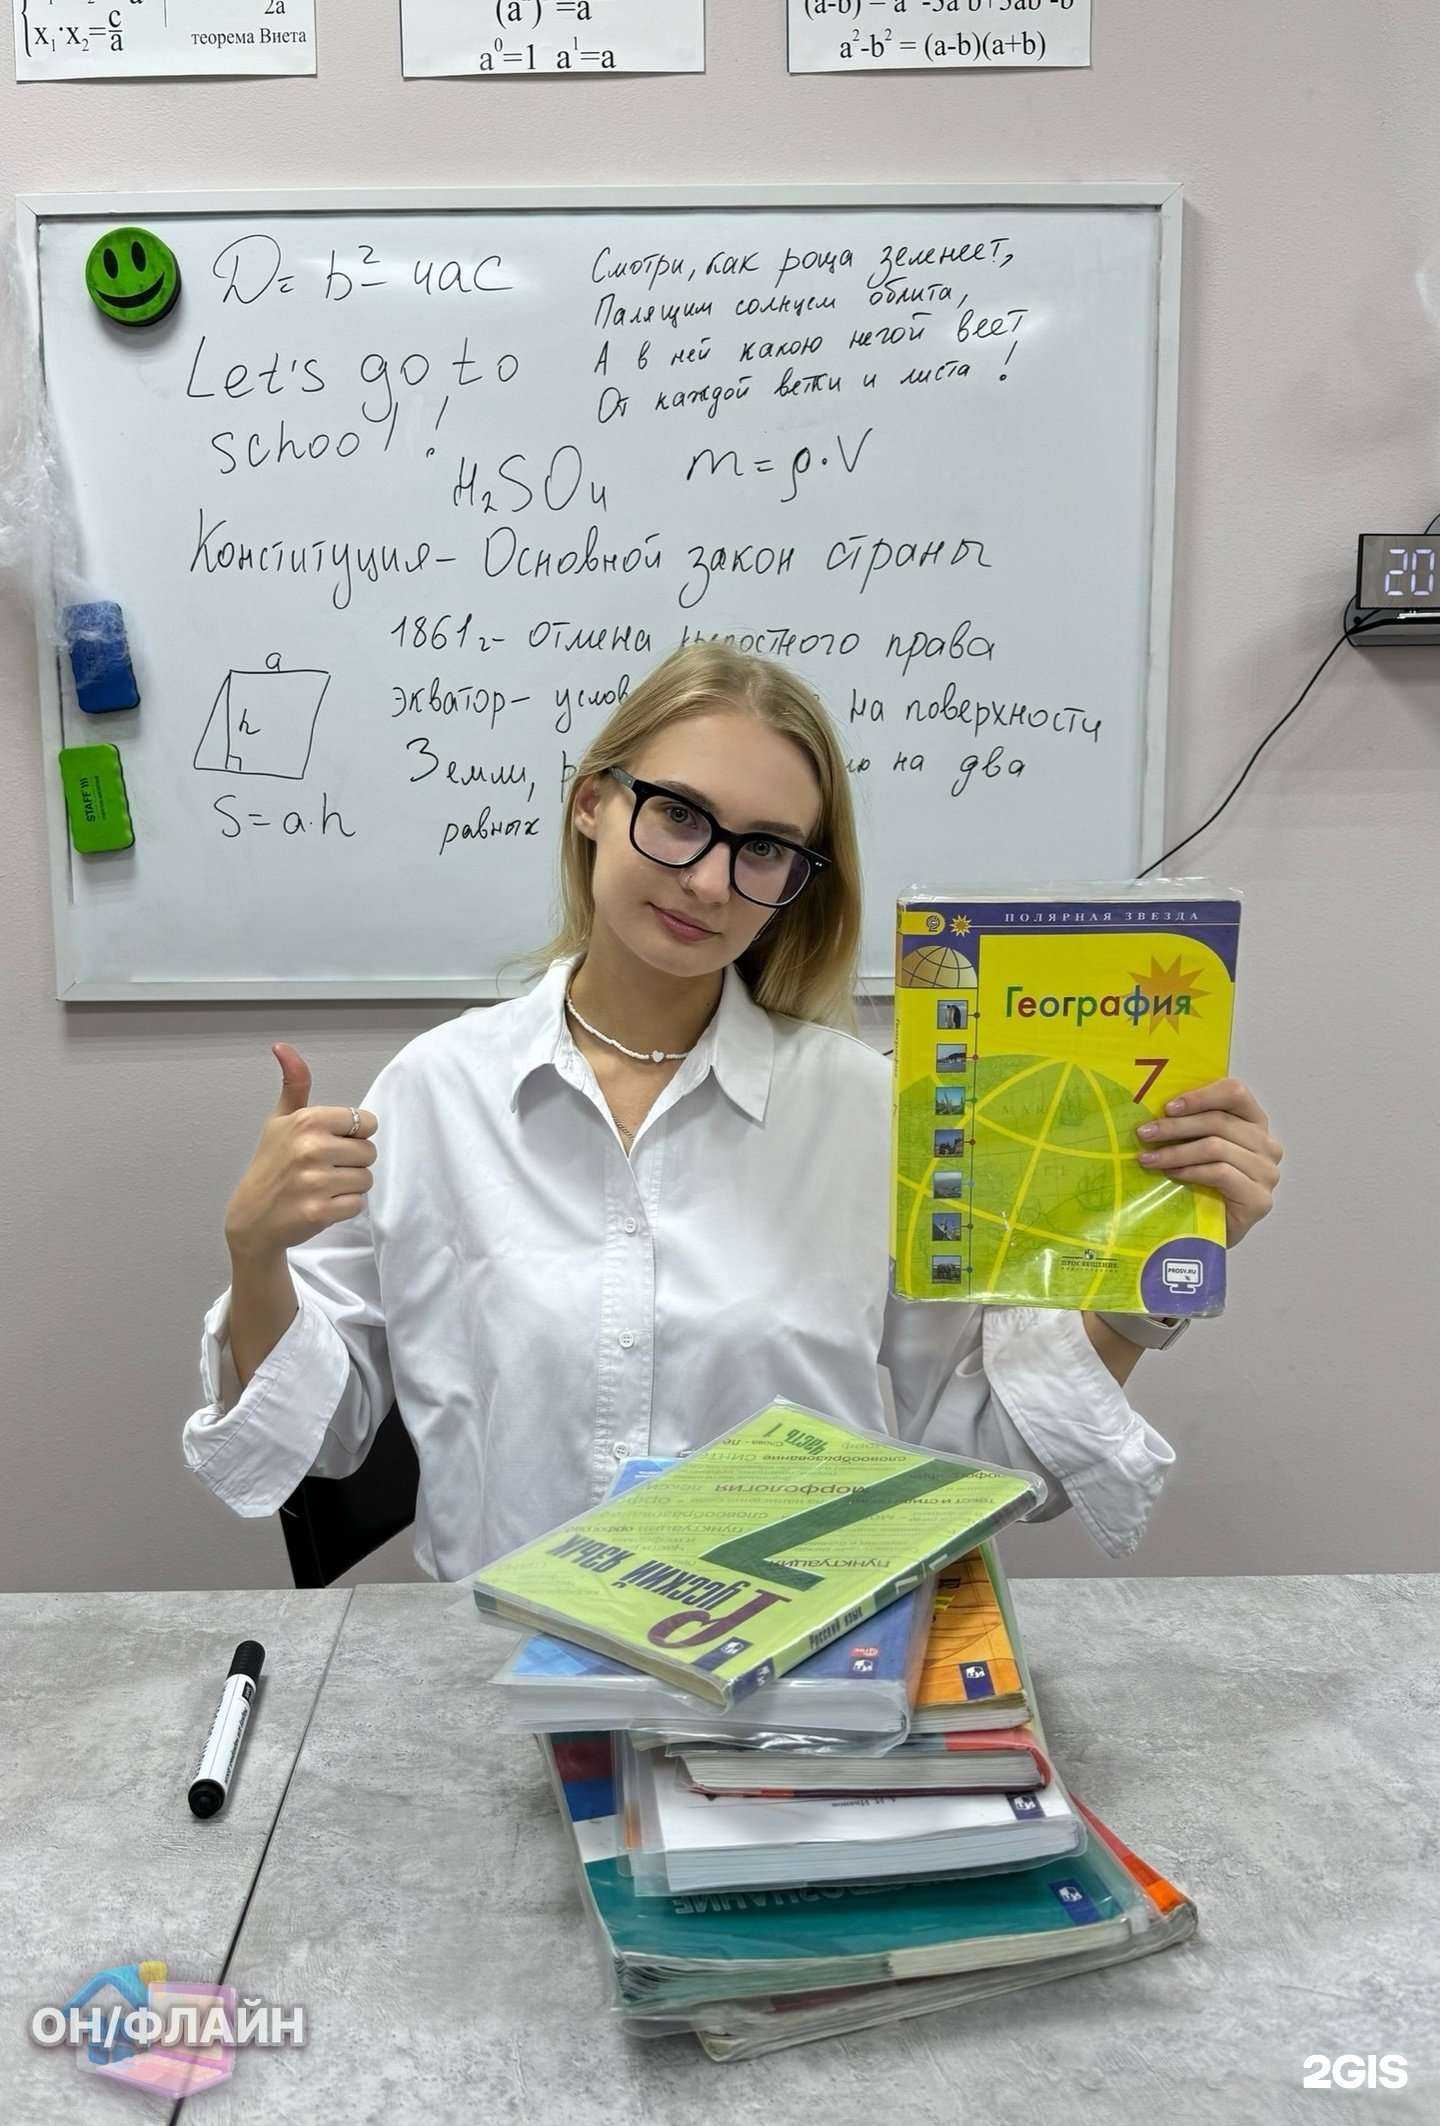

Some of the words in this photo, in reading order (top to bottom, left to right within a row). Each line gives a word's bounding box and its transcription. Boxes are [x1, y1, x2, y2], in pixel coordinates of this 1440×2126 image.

[191, 33, 255, 49] теорема
[260, 28, 307, 44] Виета
[900, 41, 916, 51] =
[592, 247, 699, 290] Смотри,
[706, 252, 760, 276] как
[775, 249, 853, 288] роща
[866, 237, 1015, 289] зеленеет,
[594, 293, 713, 329] Палящим
[735, 294, 836, 317] солнцем
[868, 278, 969, 308] облита,
[594, 341, 608, 376] А
[638, 341, 648, 370] в
[671, 337, 711, 365] ней
[740, 336, 823, 363] какою
[849, 312, 926, 348] негой
[957, 309, 1029, 343] веет
[187, 336, 325, 398] Let's
[360, 354, 430, 422] go
[599, 386, 628, 424] От
[656, 375, 750, 419] каждой
[774, 367, 842, 397] ветки
[863, 374, 877, 388] и
[900, 359, 970, 385] листа
[484, 525, 663, 578] Основной
[680, 543, 796, 608] закон
[826, 534, 993, 595] страны
[1384, 548, 1436, 596] 20
[885, 619, 996, 677] права
[850, 688, 884, 724] на
[905, 682, 1102, 743] поверхности
[405, 737, 537, 803] Земли,
[893, 752, 925, 772] на
[951, 746, 1026, 797] два
[439, 806, 541, 856] равных
[1005, 913, 1112, 923] ПОЛЯРНАЯ
[1125, 911, 1200, 921] ЗВЕЗДА
[1006, 985, 1192, 1027] География
[1132, 1058, 1170, 1105] 7
